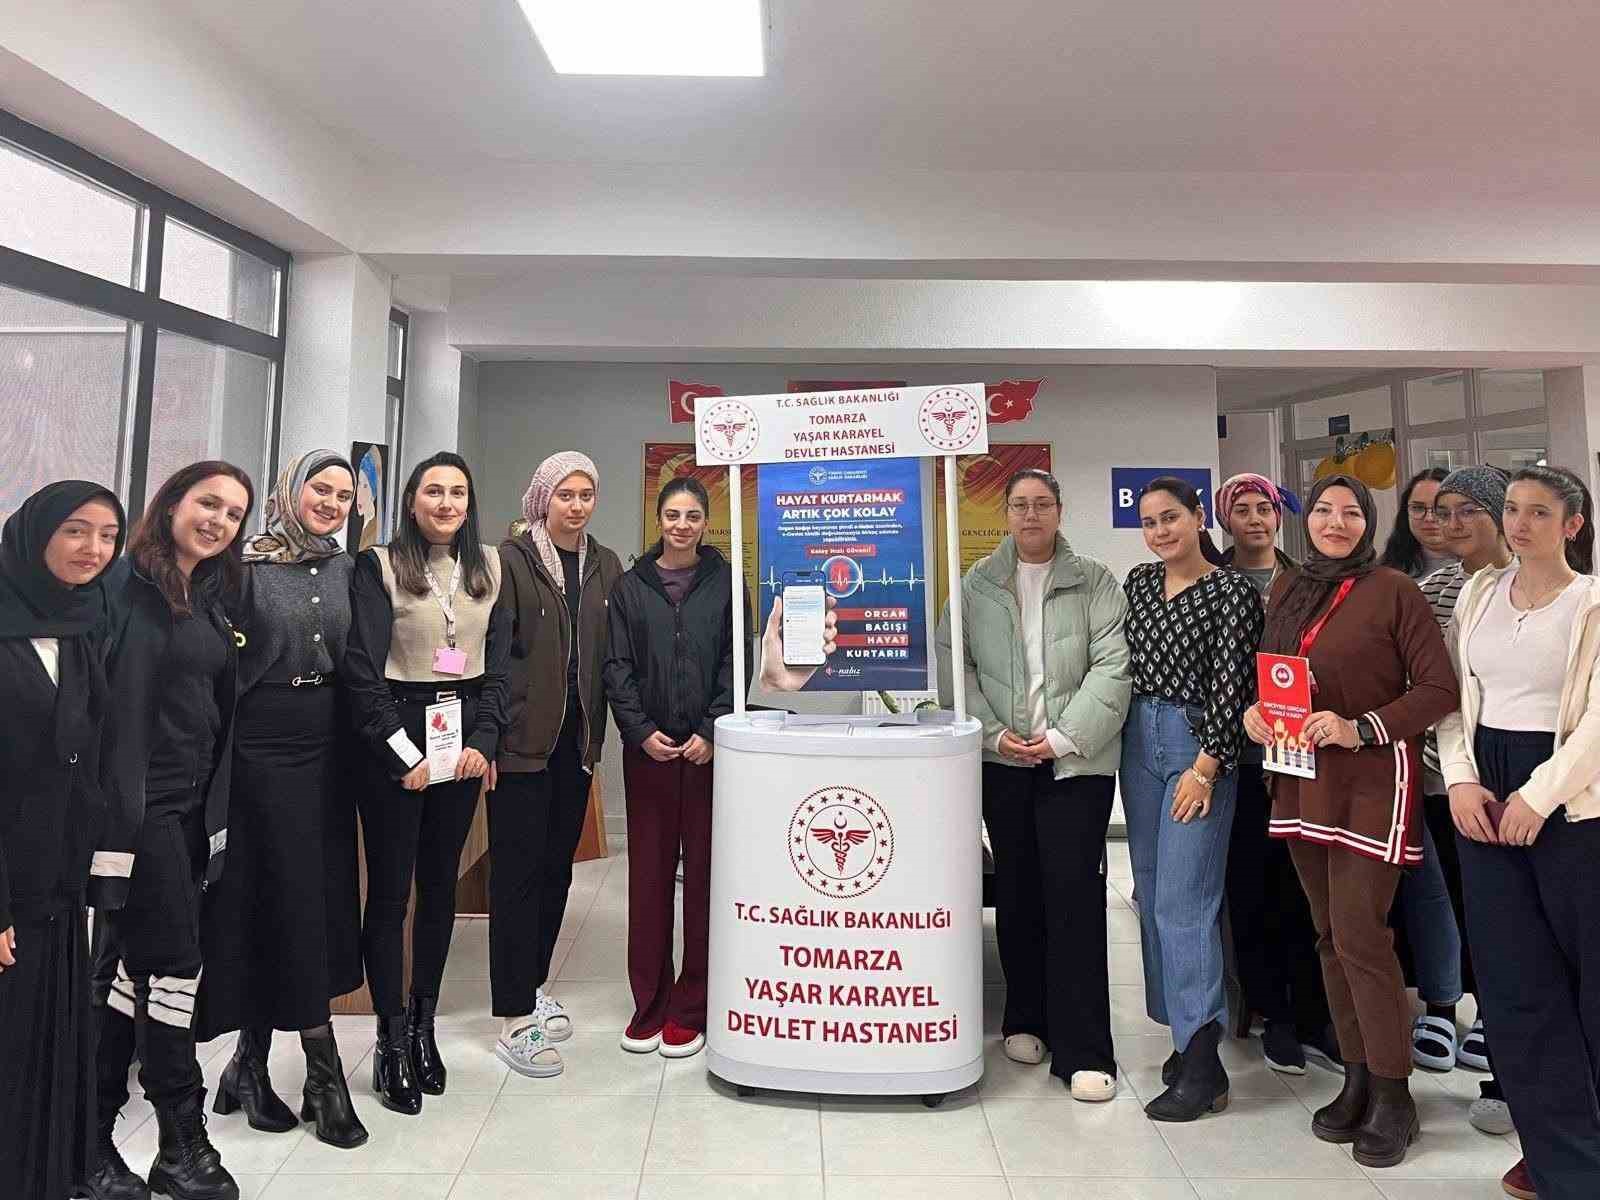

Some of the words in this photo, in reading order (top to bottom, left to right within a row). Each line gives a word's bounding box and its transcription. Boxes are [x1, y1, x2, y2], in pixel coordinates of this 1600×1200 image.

[776, 399, 794, 408] T.C.
[796, 395, 836, 407] SAĞLIK
[838, 391, 900, 405] BAKANLIĞI
[809, 412, 867, 425] TOMARZA
[793, 430, 830, 444] YAŞAR
[833, 428, 885, 440] KARAYEL
[784, 446, 829, 459] DEVLET
[831, 441, 896, 457] HASTANESİ
[776, 494, 818, 506] HAYAT
[821, 491, 903, 505] KURTARMAK
[782, 508, 820, 520] ARTIK
[823, 507, 851, 521] ÇOK
[853, 506, 897, 518] KOLAY
[864, 610, 907, 618] ORGAN
[865, 622, 907, 633] BAĞIŞI
[867, 636, 907, 645] HAYAT
[846, 649, 908, 658] KURTARIR
[734, 902, 765, 923] T.C.
[769, 905, 839, 929] SAĞLIK
[844, 907, 951, 929] BAKANLIĞI
[780, 945, 903, 971] TOMARZA
[745, 977, 823, 1007] YAŞAR
[829, 984, 940, 1007] KARAYEL
[727, 1010, 816, 1041] DEVLET
[823, 1013, 958, 1044] HASTANESİ
